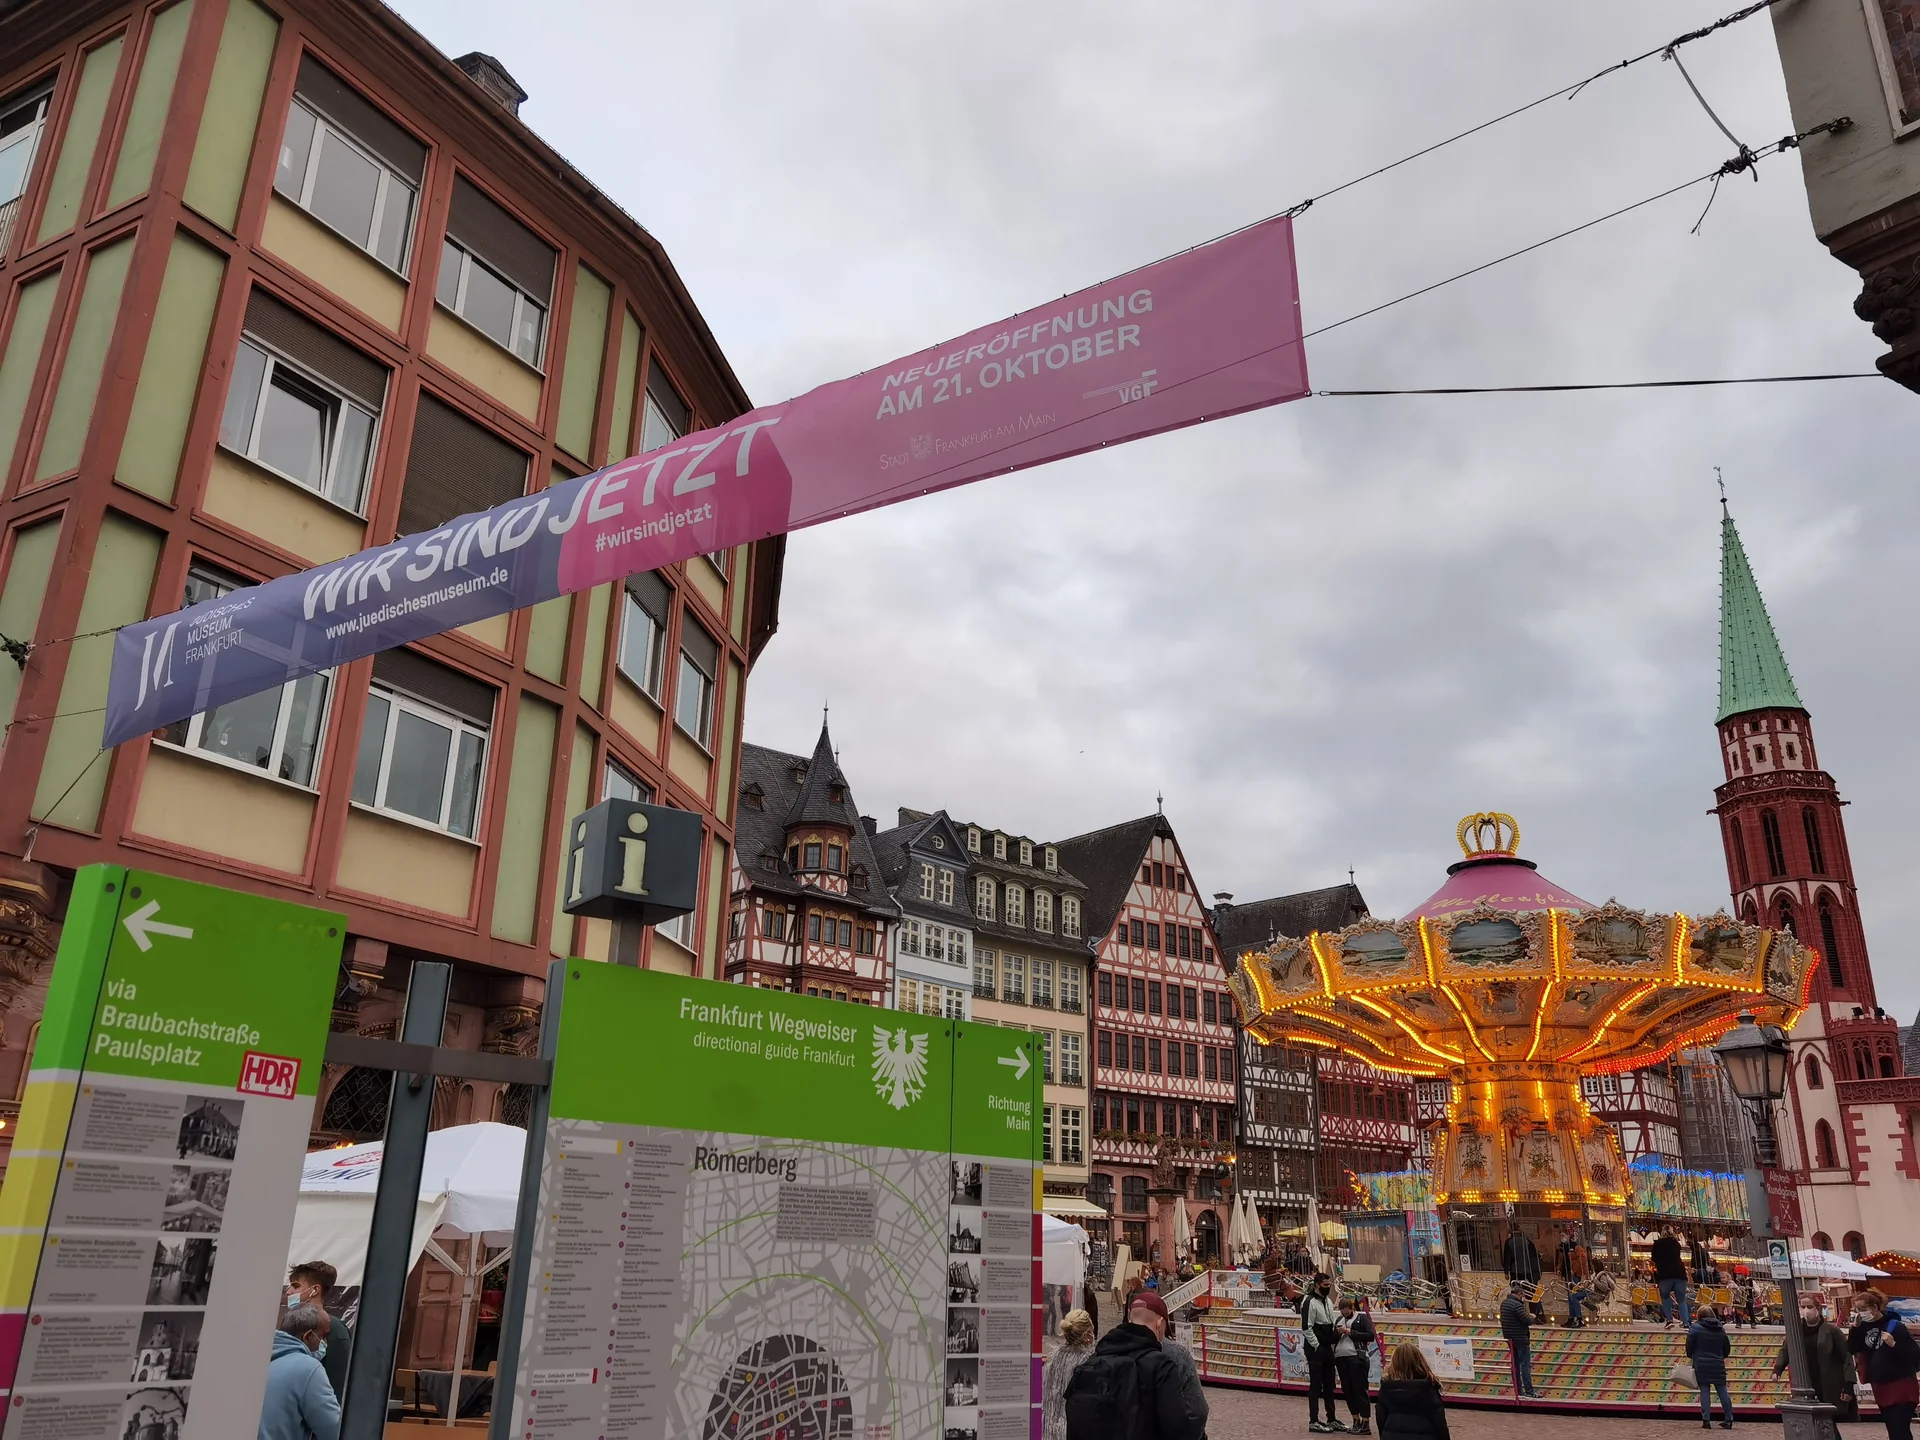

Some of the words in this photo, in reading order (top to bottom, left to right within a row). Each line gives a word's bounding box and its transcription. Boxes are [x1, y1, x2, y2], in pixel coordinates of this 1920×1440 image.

[881, 289, 1153, 391] NEUERÖFFNUNG
[876, 386, 922, 420] AM
[933, 375, 972, 403] 21.
[979, 325, 1141, 388] OKTOBER
[1119, 370, 1158, 404] VGF
[303, 547, 407, 620] WIR
[406, 498, 550, 582] SIND
[548, 418, 782, 534] JETZT
[595, 502, 713, 551] #wirsindjetzt
[325, 567, 508, 639] www.juedischesmuseum.de
[185, 628, 244, 665] FRANKFURT
[187, 615, 233, 646] MUSEUM
[107, 978, 137, 1000] via
[101, 1005, 260, 1045] Braubachstraße
[679, 997, 763, 1030] Frankfurt
[768, 1011, 857, 1043] Wegweiser
[95, 1034, 202, 1066] Paulsplatz
[693, 1032, 762, 1056] directional
[764, 1041, 799, 1060] guide
[803, 1046, 856, 1067] Frankfurt
[244, 1057, 294, 1095] HDR
[988, 1095, 1031, 1116] Richtung
[1006, 1115, 1031, 1131] Main
[694, 1146, 798, 1182] Römerberg
